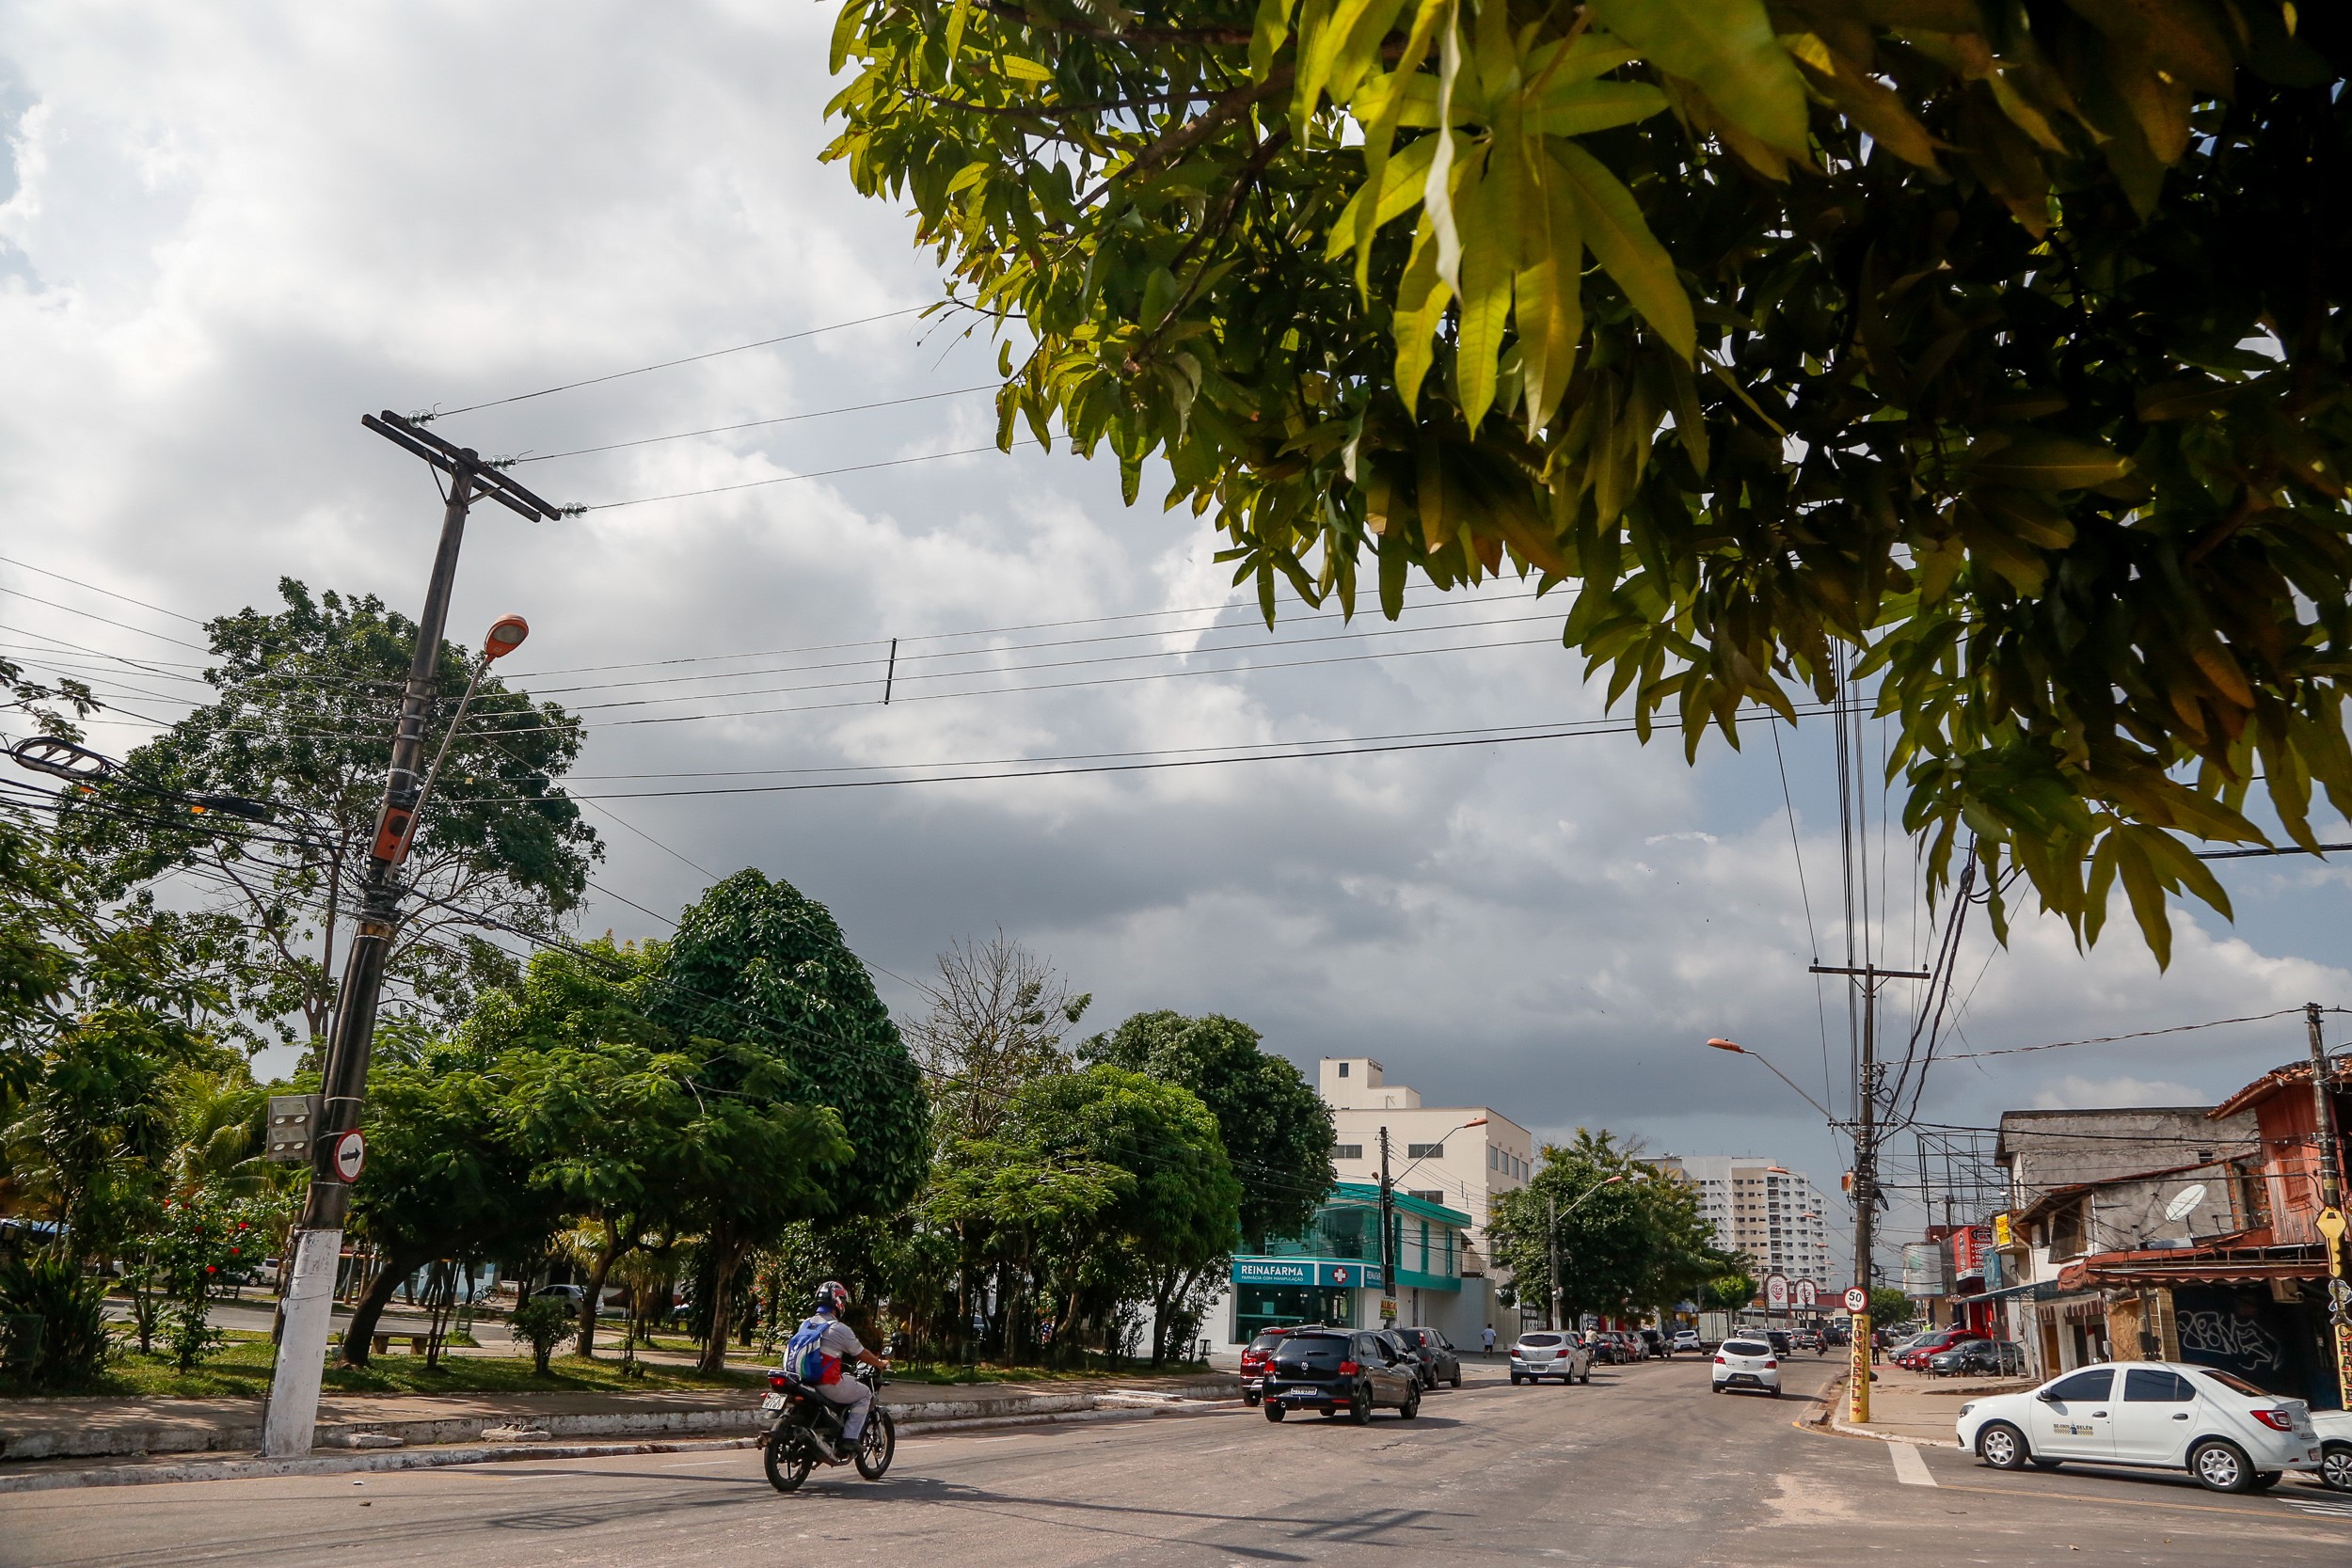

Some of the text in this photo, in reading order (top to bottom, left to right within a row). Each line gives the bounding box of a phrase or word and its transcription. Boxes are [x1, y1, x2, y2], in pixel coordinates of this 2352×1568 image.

[1241, 1265, 1304, 1276] REINAFARMA
[1849, 1291, 1862, 1303] 50
[1851, 1318, 1865, 1402] TONCELL
